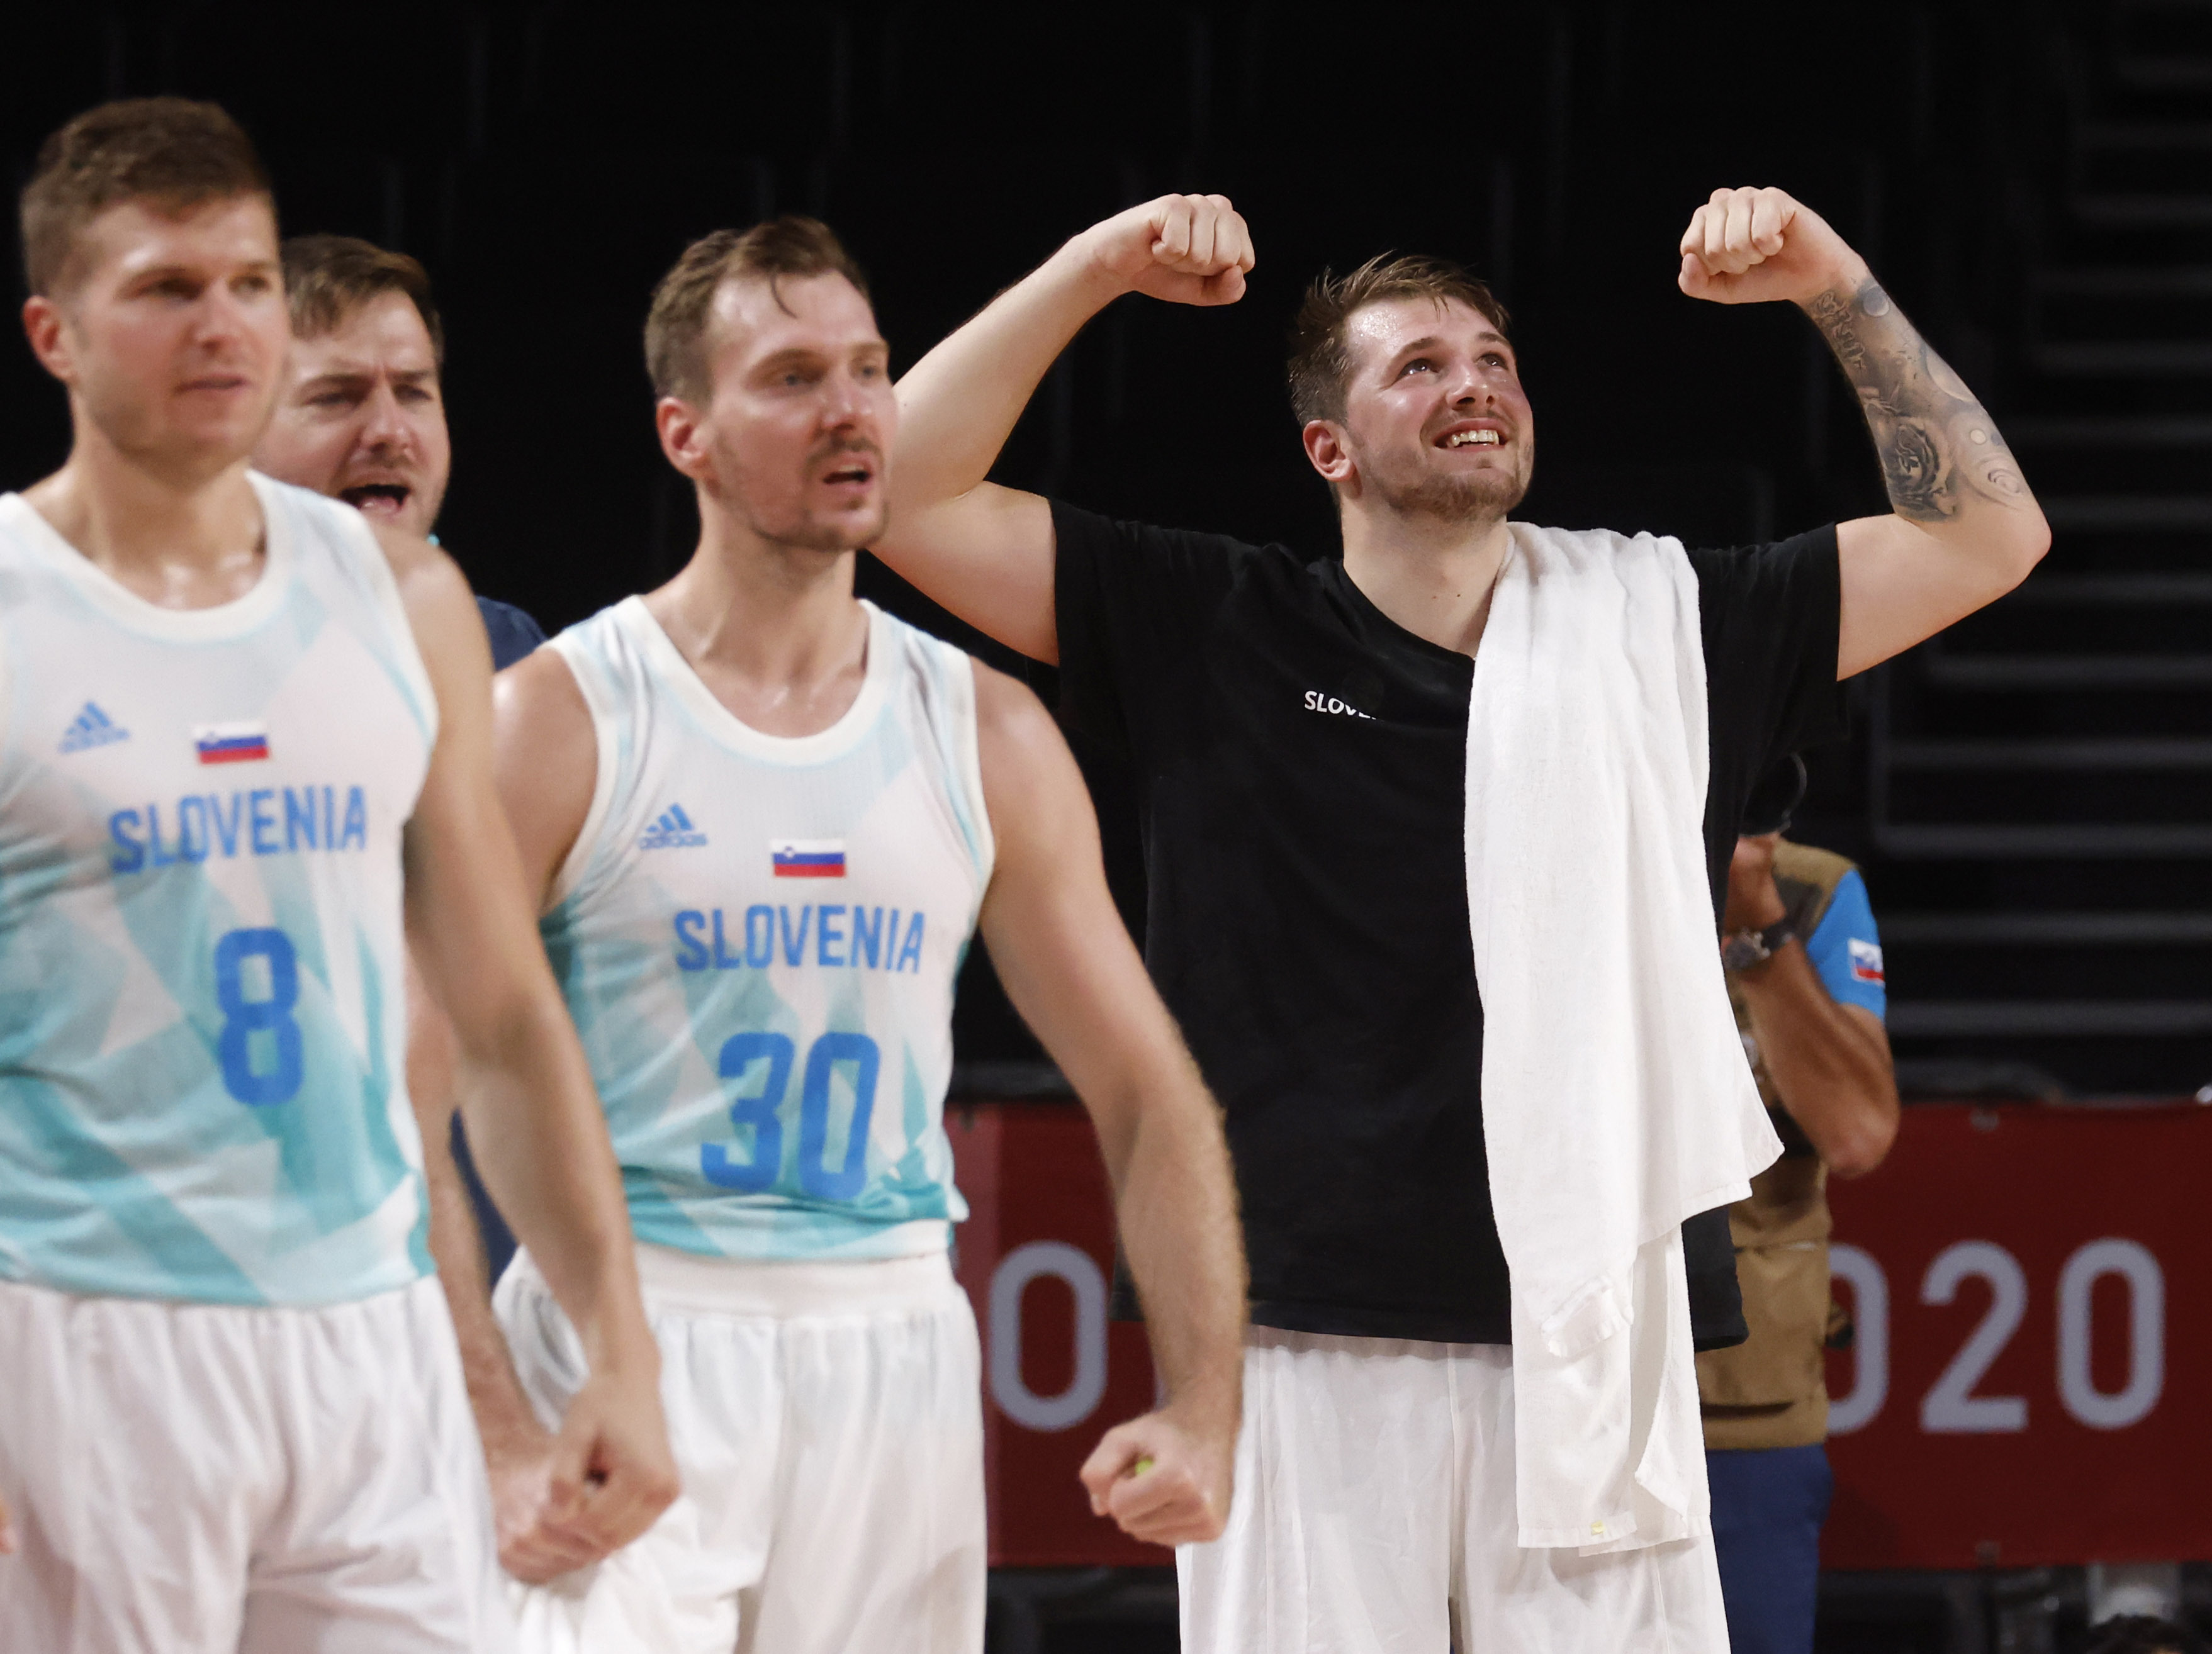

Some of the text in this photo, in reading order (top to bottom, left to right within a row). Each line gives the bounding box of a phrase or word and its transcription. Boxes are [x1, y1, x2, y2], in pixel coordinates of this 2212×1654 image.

[109, 785, 368, 874] SLOVENIA
[673, 903, 926, 974] SLOVENIA
[215, 927, 305, 1107] 8
[700, 1031, 881, 1200] 30
